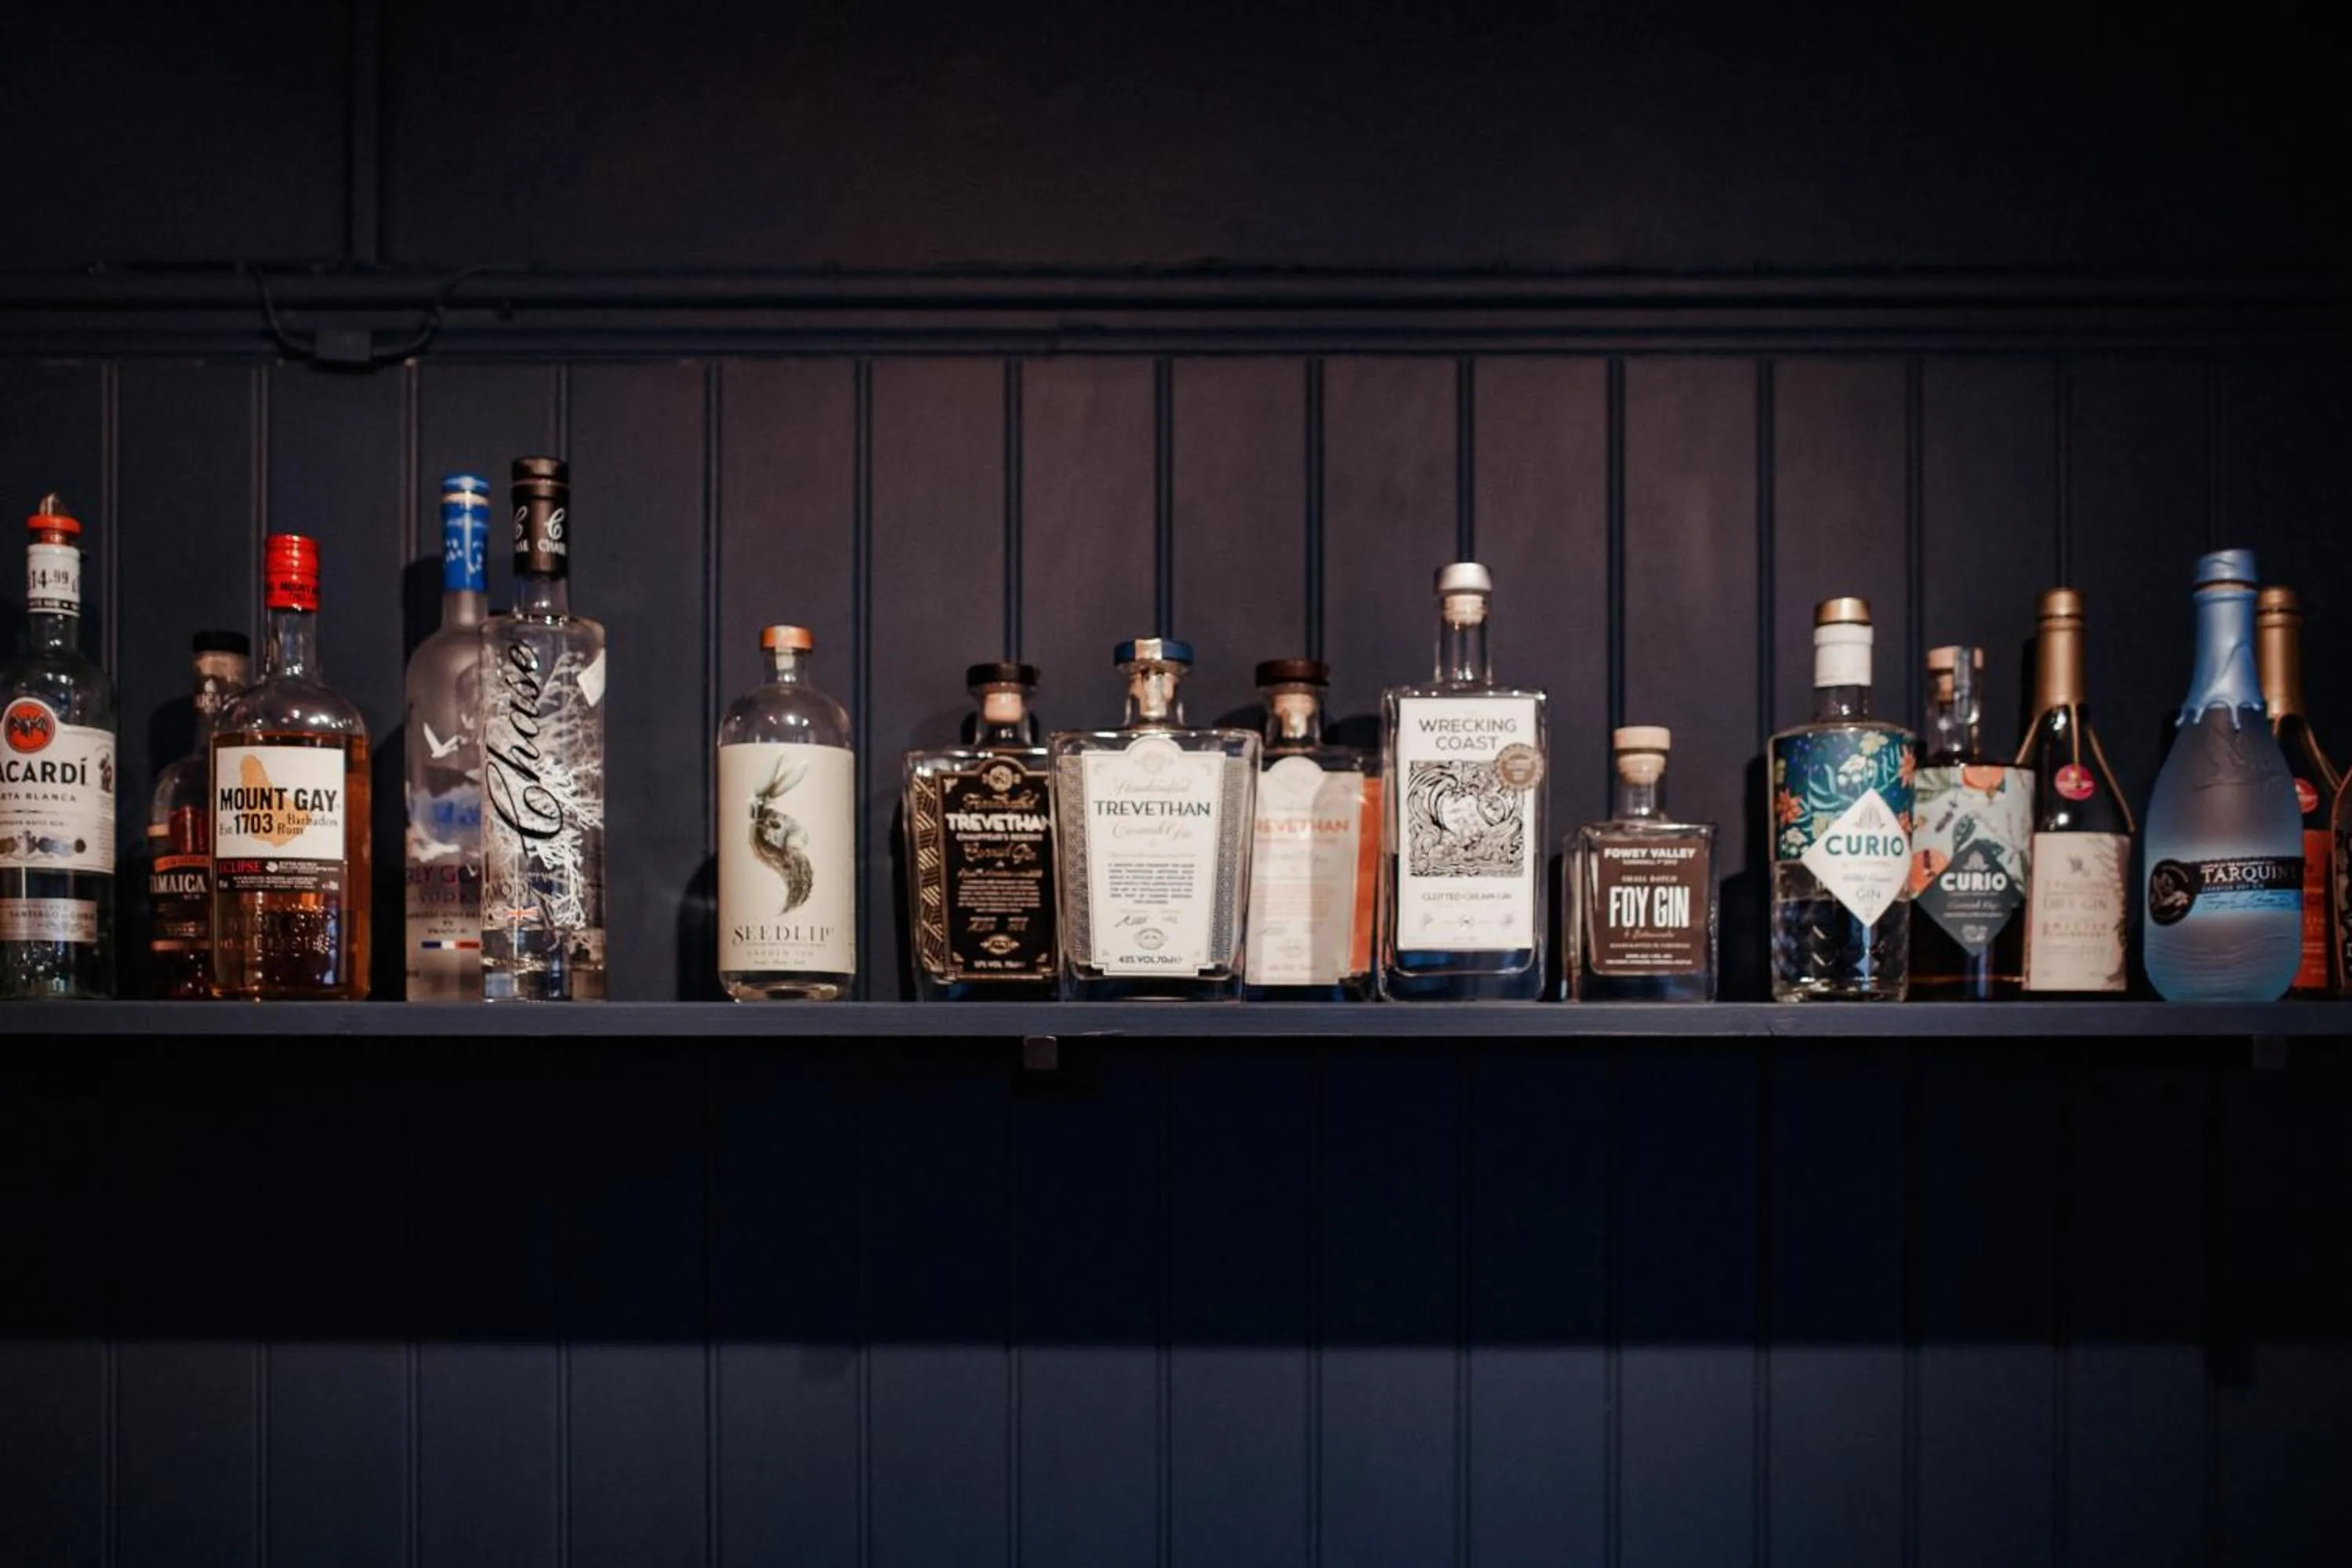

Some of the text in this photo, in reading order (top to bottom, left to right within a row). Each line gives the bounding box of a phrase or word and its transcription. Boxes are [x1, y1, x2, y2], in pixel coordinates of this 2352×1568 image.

[1419, 718, 1517, 733] WRECKING
[1436, 736, 1499, 750] COAST
[220, 788, 337, 812] MOUNT GAY
[1094, 800, 1211, 816] TREVETHAN
[234, 813, 274, 834] 1703
[946, 813, 1048, 831] TREVETHAN
[1254, 819, 1350, 833] REVETHAN
[1604, 848, 1696, 858] FOWEY VALLEY
[1825, 835, 1904, 857] CURIO
[220, 862, 261, 873] ECLIPSE
[150, 873, 208, 893] AMAICA
[1940, 872, 2007, 891] CURIO
[1855, 888, 1881, 901] GIN
[1610, 886, 1690, 928] FOY GIN
[732, 925, 829, 946] SEEDLIP
